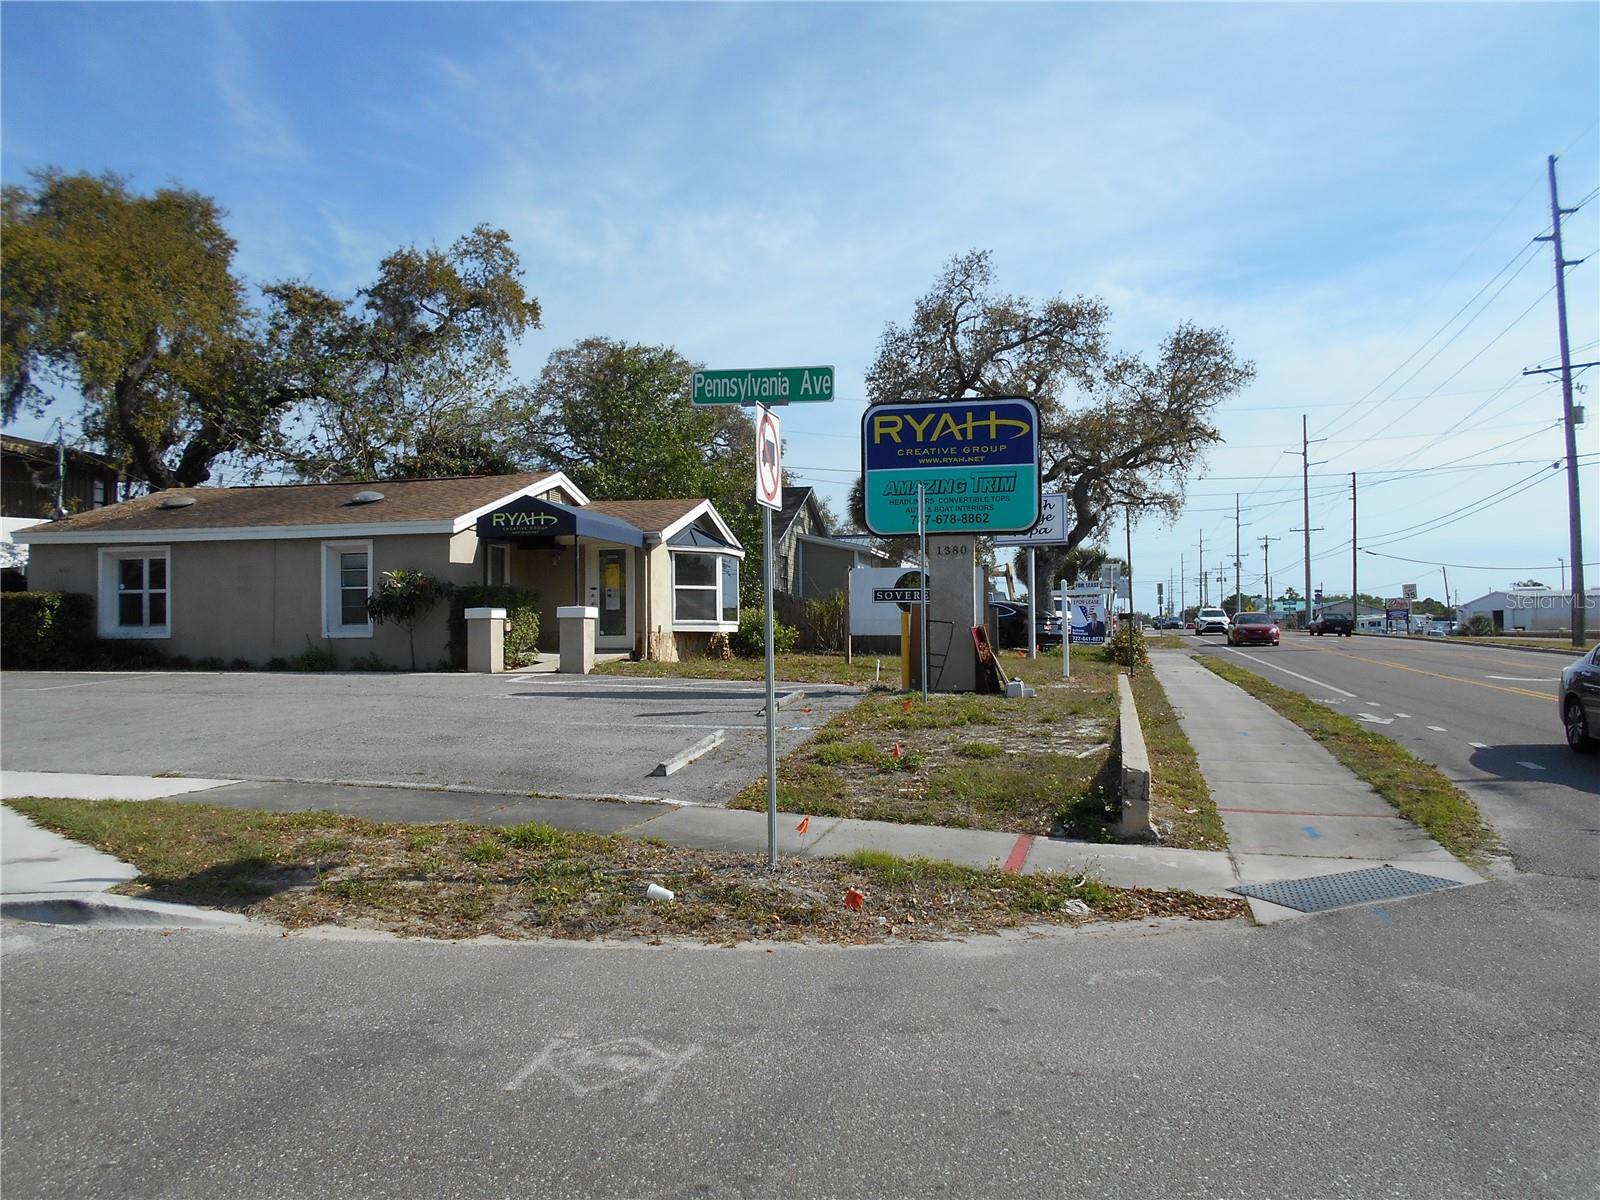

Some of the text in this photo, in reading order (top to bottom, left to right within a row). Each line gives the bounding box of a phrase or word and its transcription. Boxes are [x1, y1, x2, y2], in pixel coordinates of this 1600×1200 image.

[694, 370, 832, 400] Pennsylvania Ave
[873, 410, 1031, 444] RYAH
[897, 445, 1007, 456] CREATIVE GROUP
[918, 456, 985, 464] WWW.RYAH.NET
[883, 471, 1017, 496] AMAZING TRIM
[938, 496, 988, 504] CONVERTIBLE
[955, 504, 994, 512] INTERIORS
[493, 511, 558, 527] RYAH
[911, 513, 989, 525] 77-678-8862
[937, 545, 967, 555] 1380
